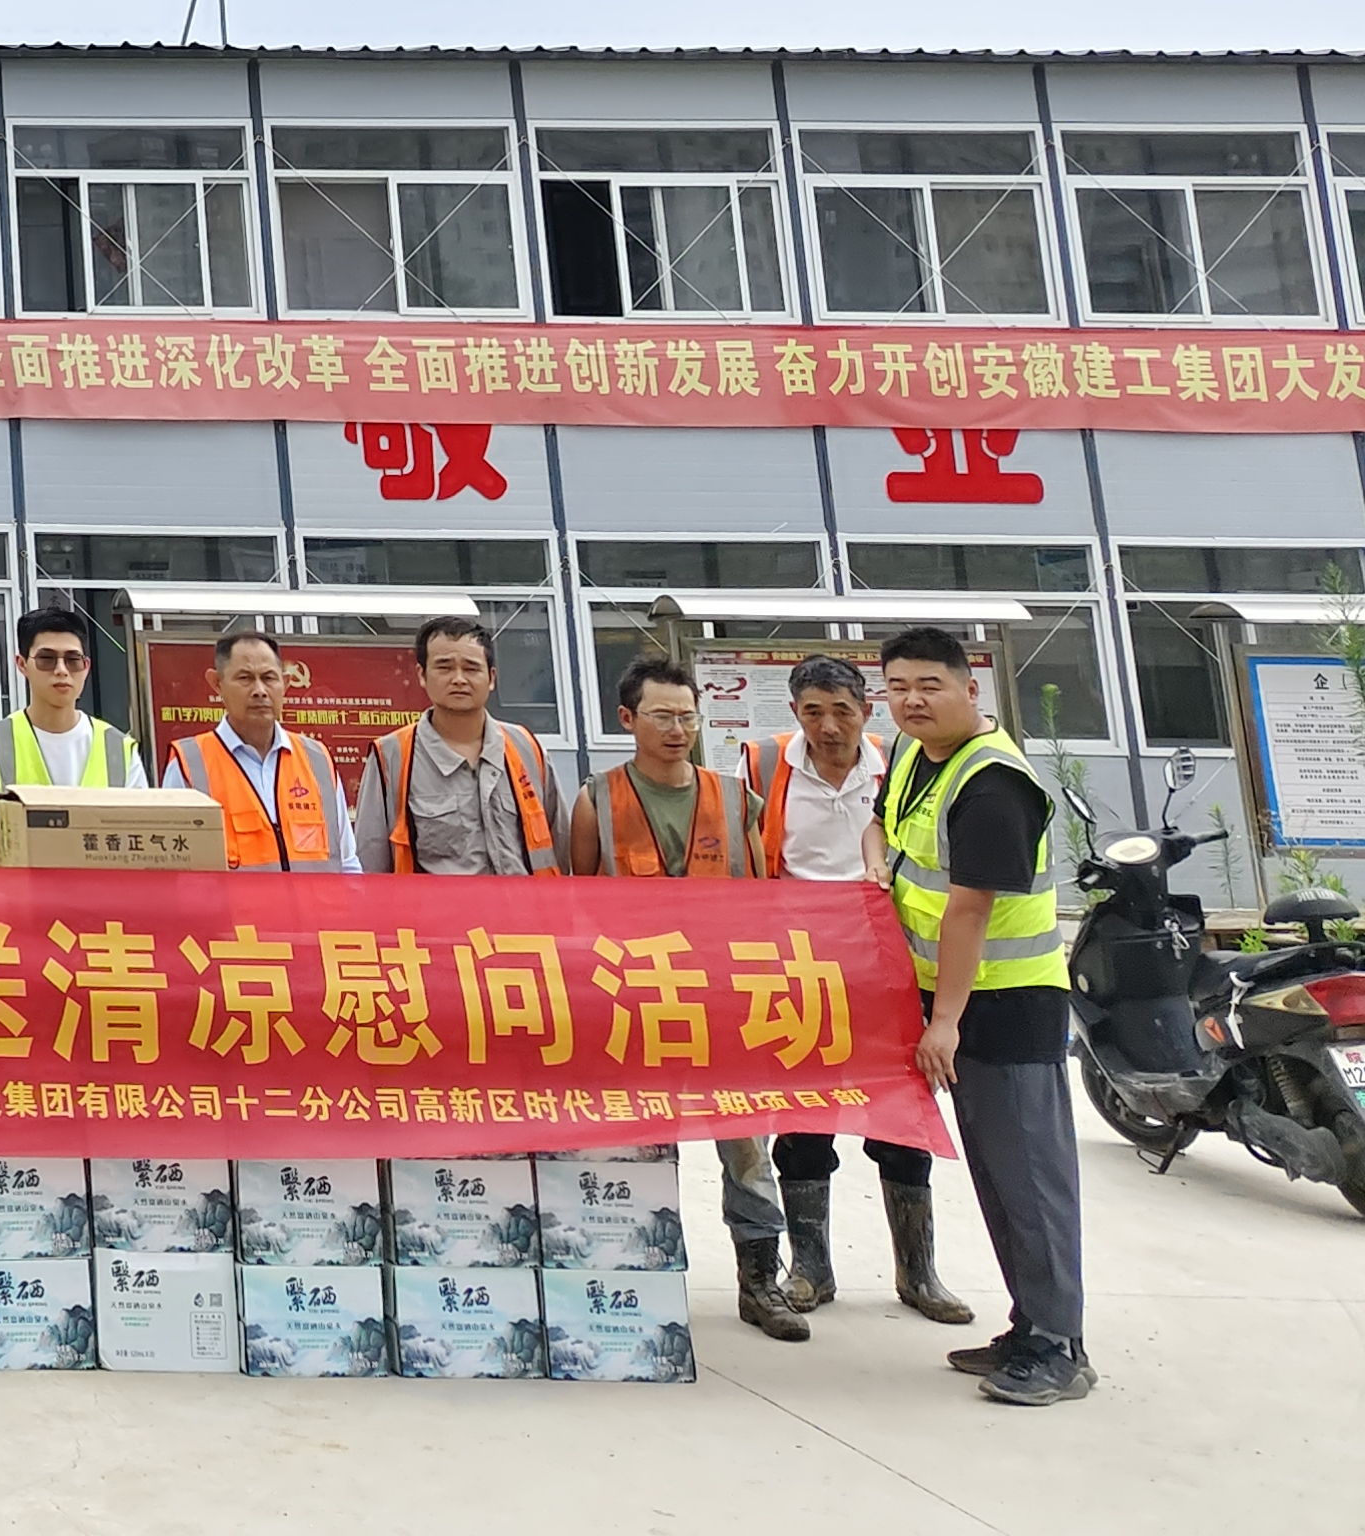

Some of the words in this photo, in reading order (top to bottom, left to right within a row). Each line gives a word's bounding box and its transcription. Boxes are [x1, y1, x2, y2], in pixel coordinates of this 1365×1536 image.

[364, 336, 760, 397] 全面推进创新发展
[774, 338, 1365, 403] 奋力开创安徽建工集团大发
[82, 833, 190, 853] 藿香正气水
